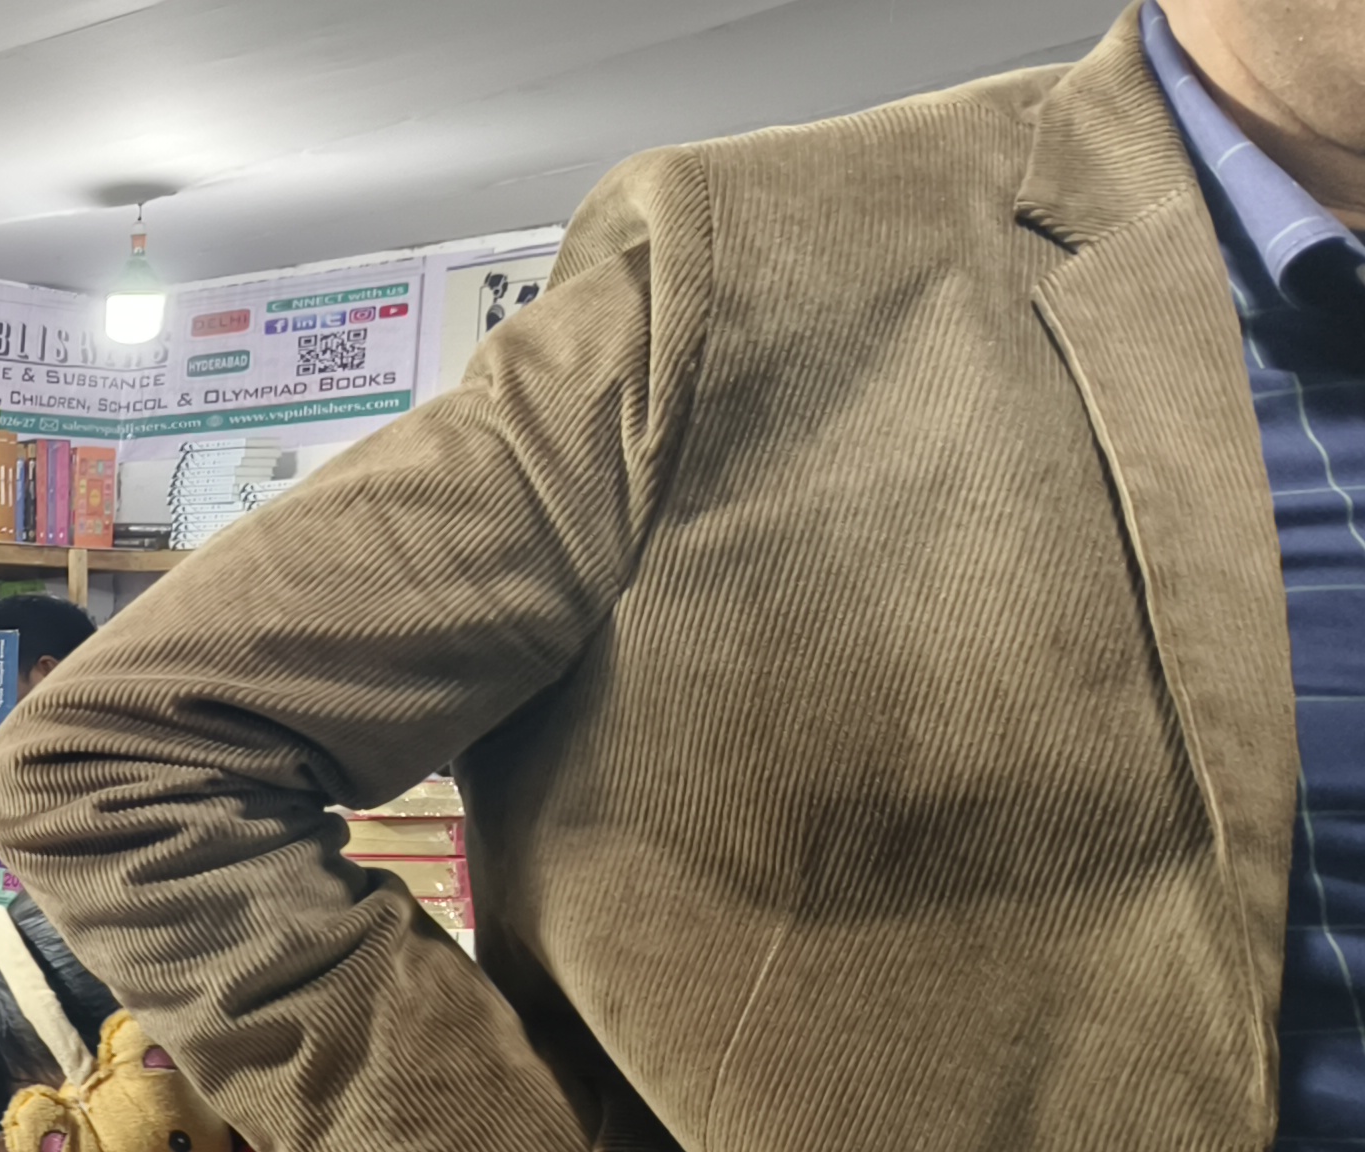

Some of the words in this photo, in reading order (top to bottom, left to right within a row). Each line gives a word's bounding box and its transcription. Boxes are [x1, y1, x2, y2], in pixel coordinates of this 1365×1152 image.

[348, 289, 382, 301] with
[386, 287, 404, 296] us
[192, 313, 249, 331] DELHI
[189, 355, 248, 372] HYDERABAD
[21, 367, 35, 382] &
[46, 369, 166, 390] SUBSTANCE
[10, 391, 91, 412] CHILDREN,
[98, 398, 167, 413] SCHOOL
[177, 393, 193, 407] &
[204, 382, 307, 404] OLYMPIAD
[319, 372, 396, 391] BOOKS
[228, 398, 399, 424] www.vspublishers.com
